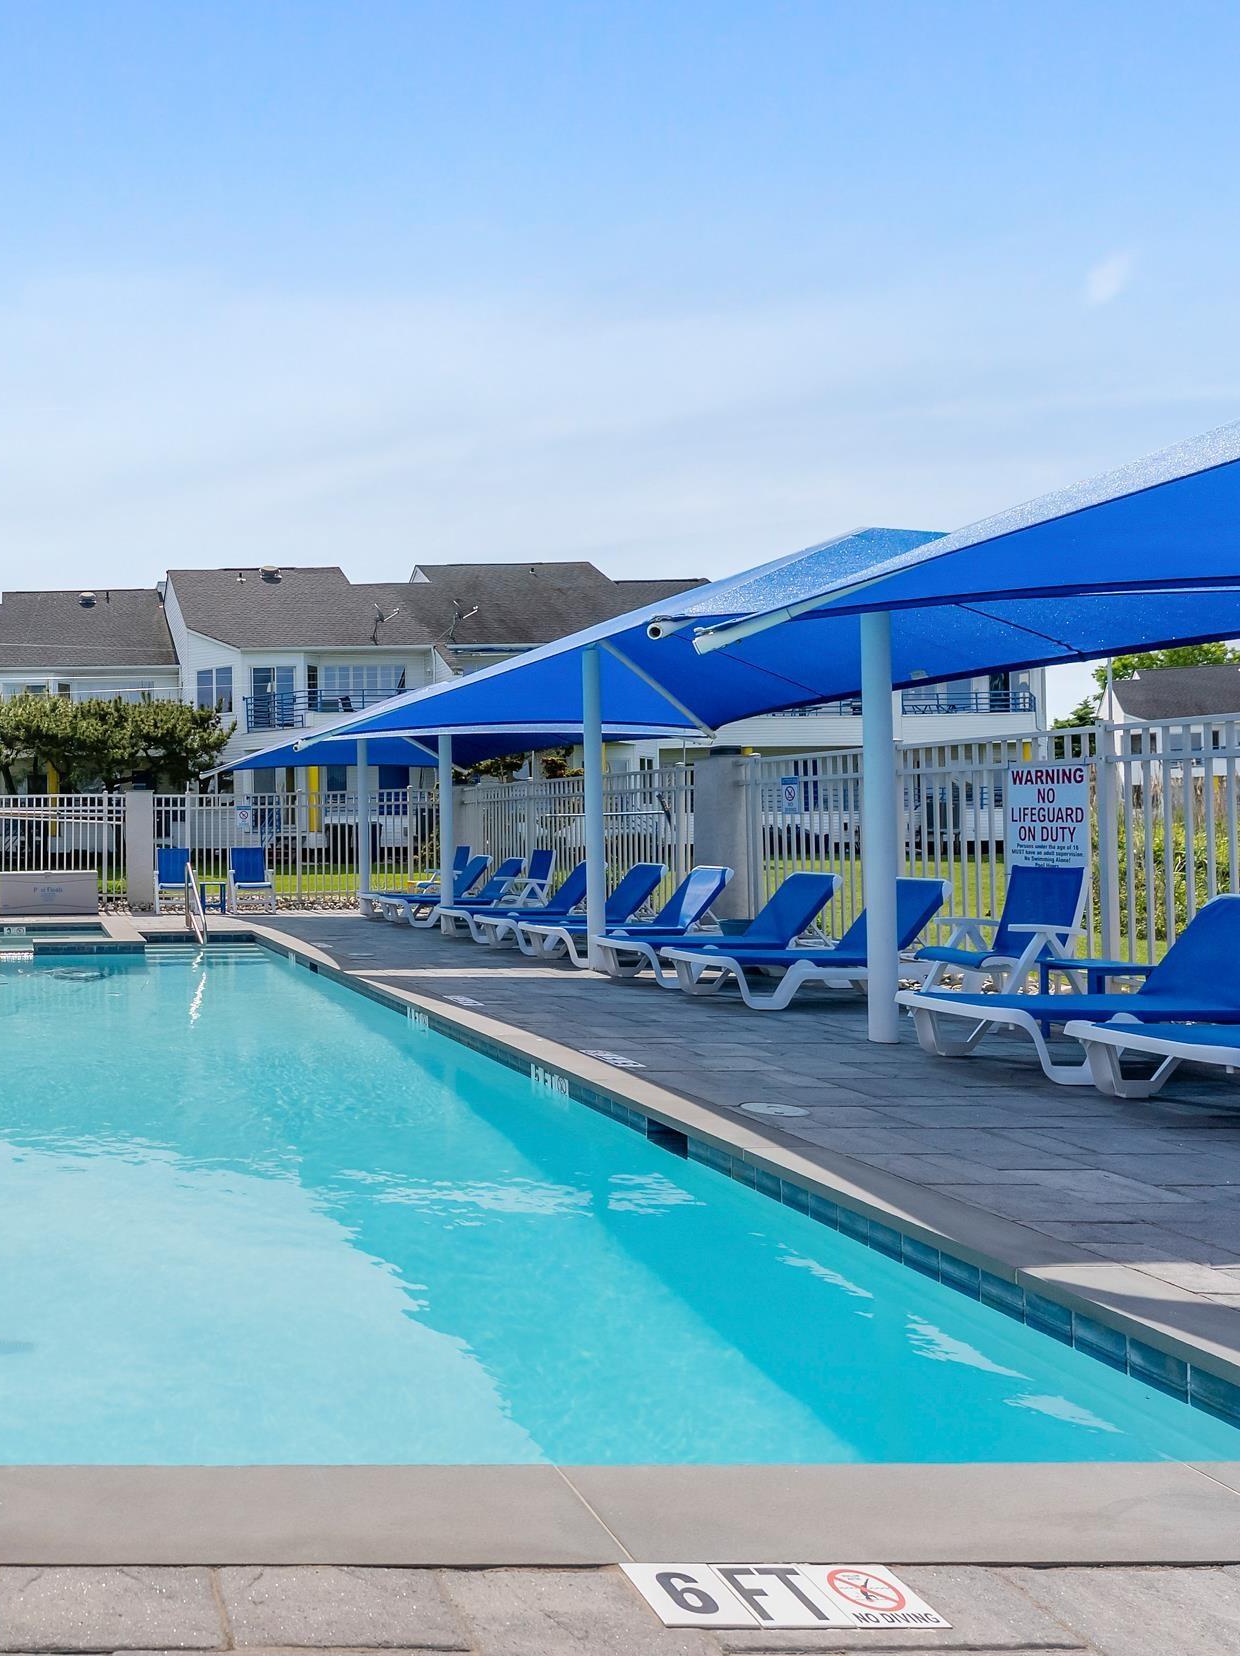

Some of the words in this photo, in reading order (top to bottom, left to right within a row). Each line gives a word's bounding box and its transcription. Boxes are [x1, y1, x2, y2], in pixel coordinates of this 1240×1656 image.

[1011, 768, 1084, 785] WARNING
[1037, 788, 1055, 804] NO
[1011, 807, 1084, 823] LIFEGUARD
[1018, 825, 1036, 842] ON
[1041, 826, 1077, 843] DUTY
[655, 1571, 720, 1615] 6
[716, 1567, 831, 1621] FT
[851, 1612, 881, 1624] NO
[880, 1612, 941, 1624] DIVING
